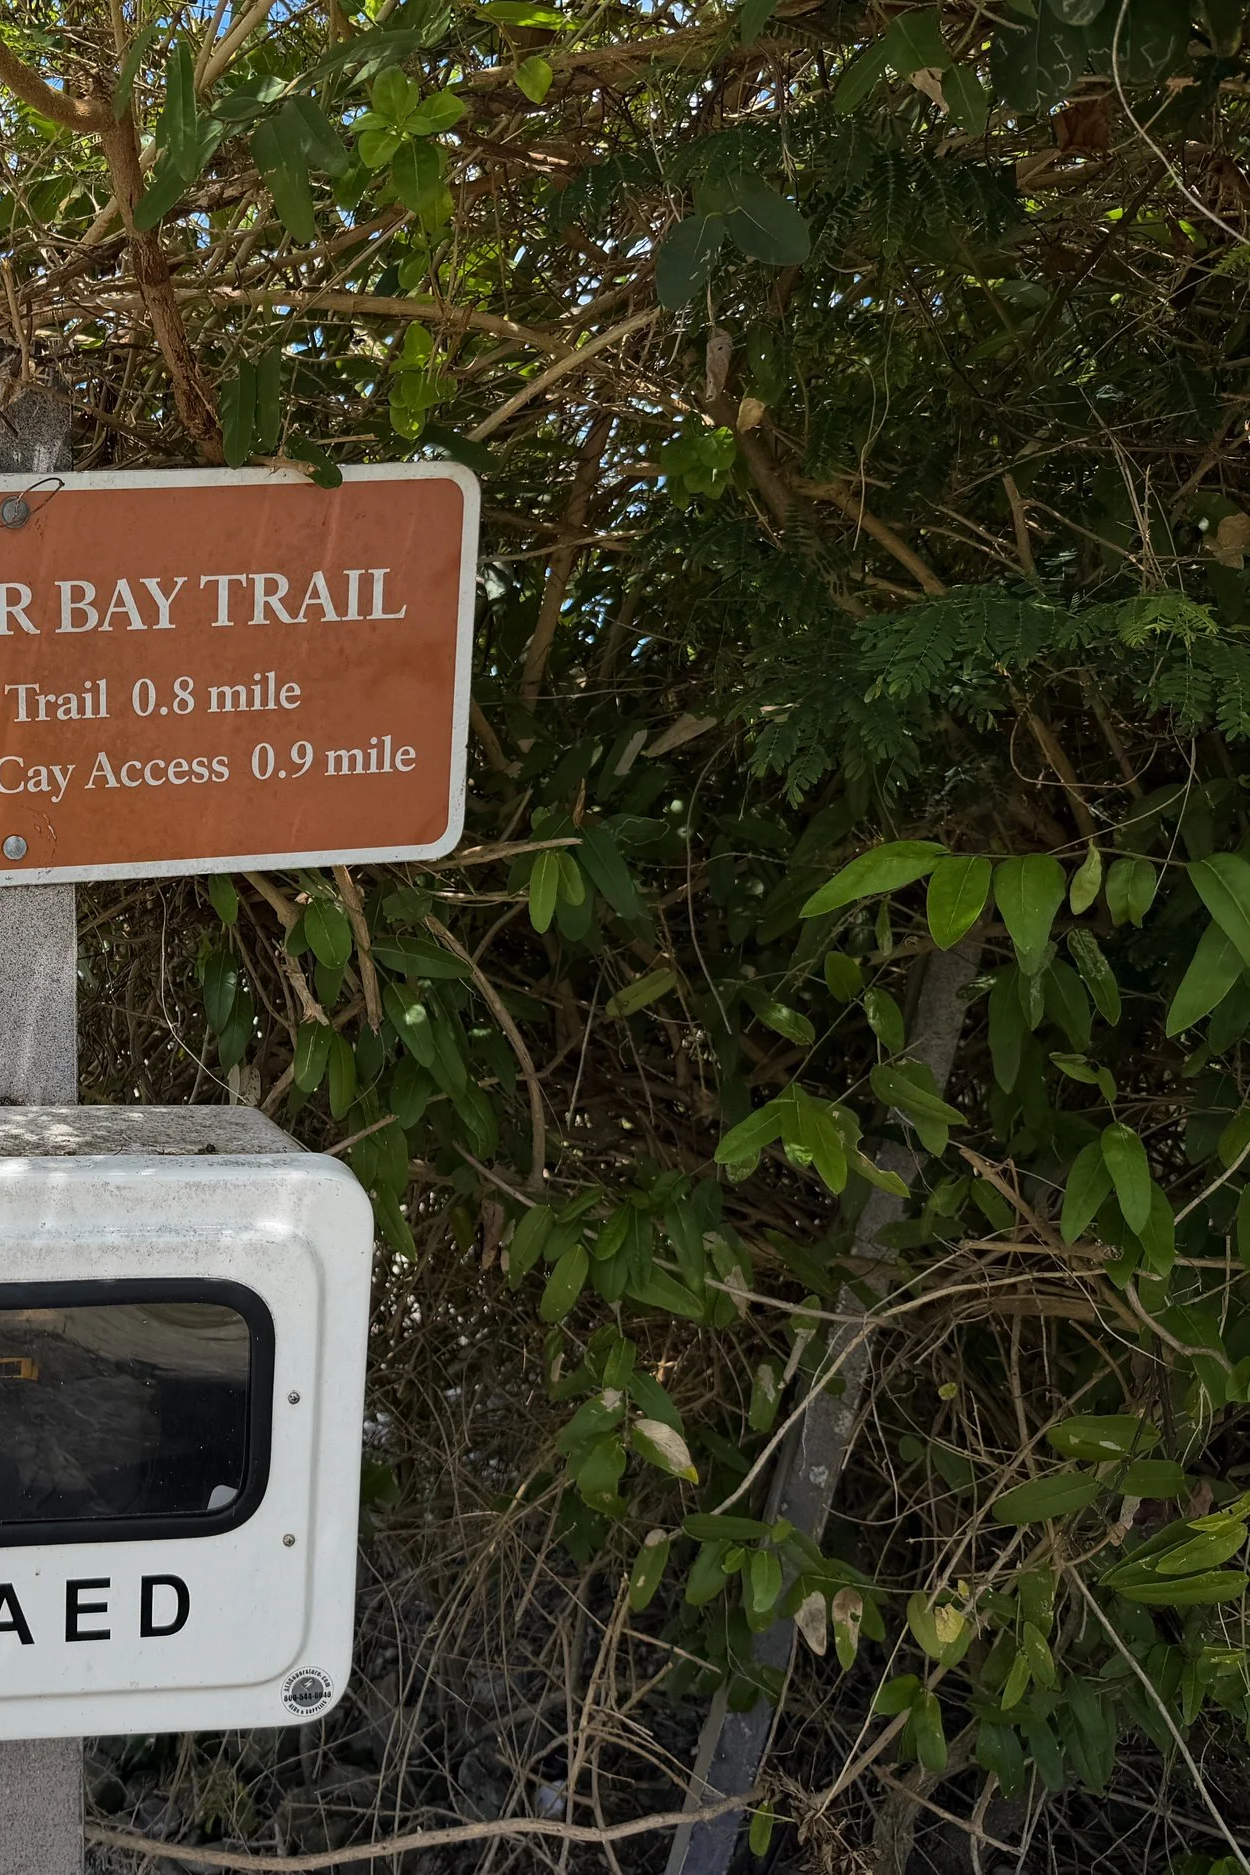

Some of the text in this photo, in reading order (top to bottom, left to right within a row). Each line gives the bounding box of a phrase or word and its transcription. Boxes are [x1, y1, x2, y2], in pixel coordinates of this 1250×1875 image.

[55, 577, 188, 633] BAY
[200, 568, 407, 627] TRAIL
[4, 678, 109, 722] Trail
[132, 677, 195, 717] 0.8
[207, 670, 302, 713] mile
[84, 751, 230, 789] Access
[251, 740, 314, 780] 0.9
[324, 734, 416, 776] mile
